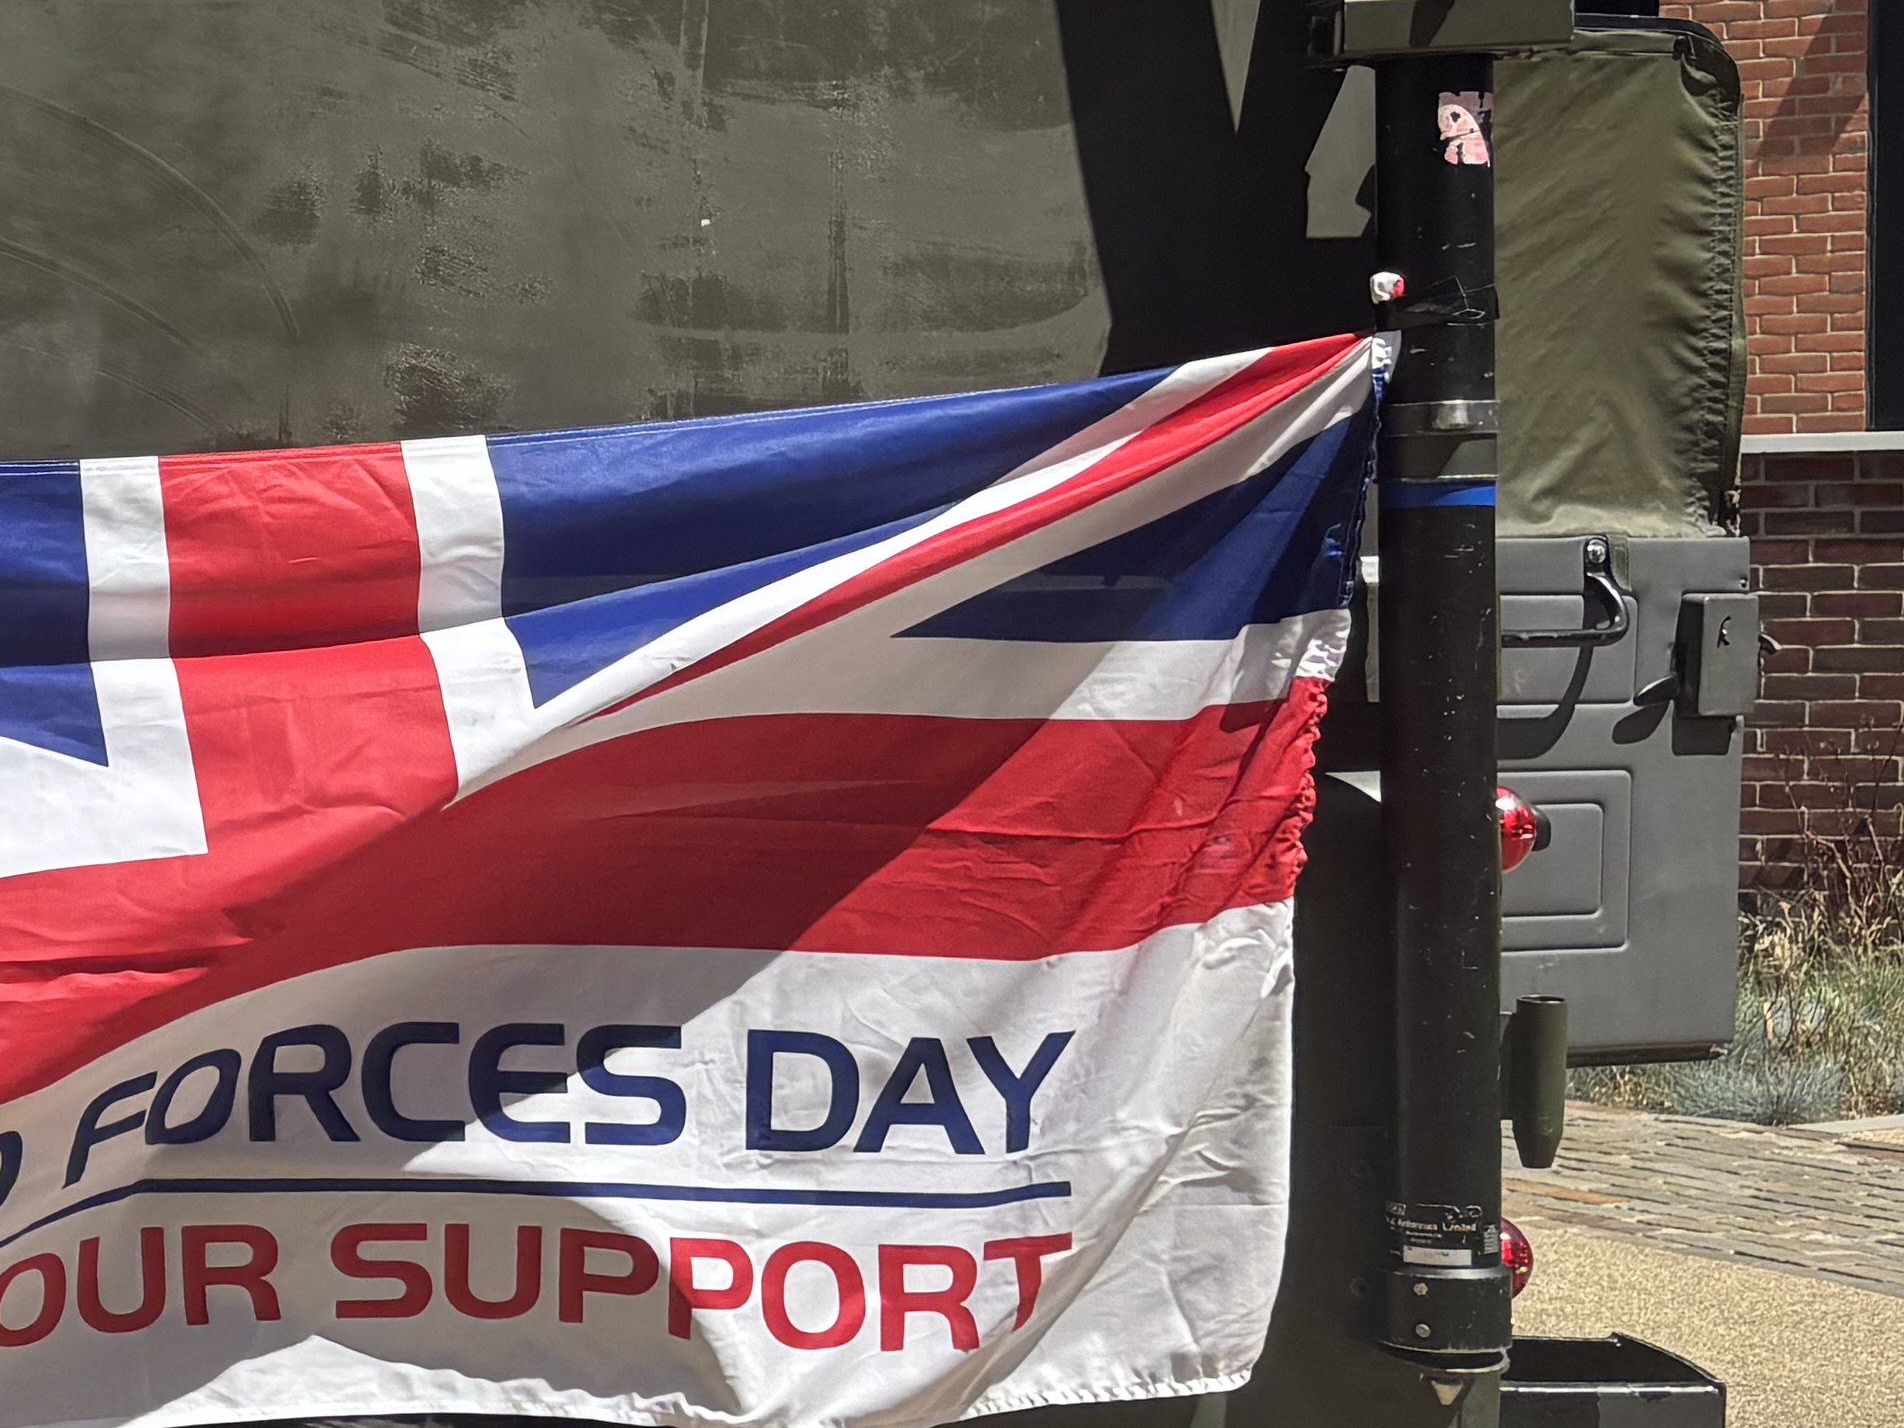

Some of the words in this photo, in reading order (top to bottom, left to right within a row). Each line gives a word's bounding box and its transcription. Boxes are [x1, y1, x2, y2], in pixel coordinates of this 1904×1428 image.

[64, 1021, 687, 1189] FORCES
[745, 1029, 1076, 1155] DAY
[330, 1222, 1073, 1353] SUPPORT
